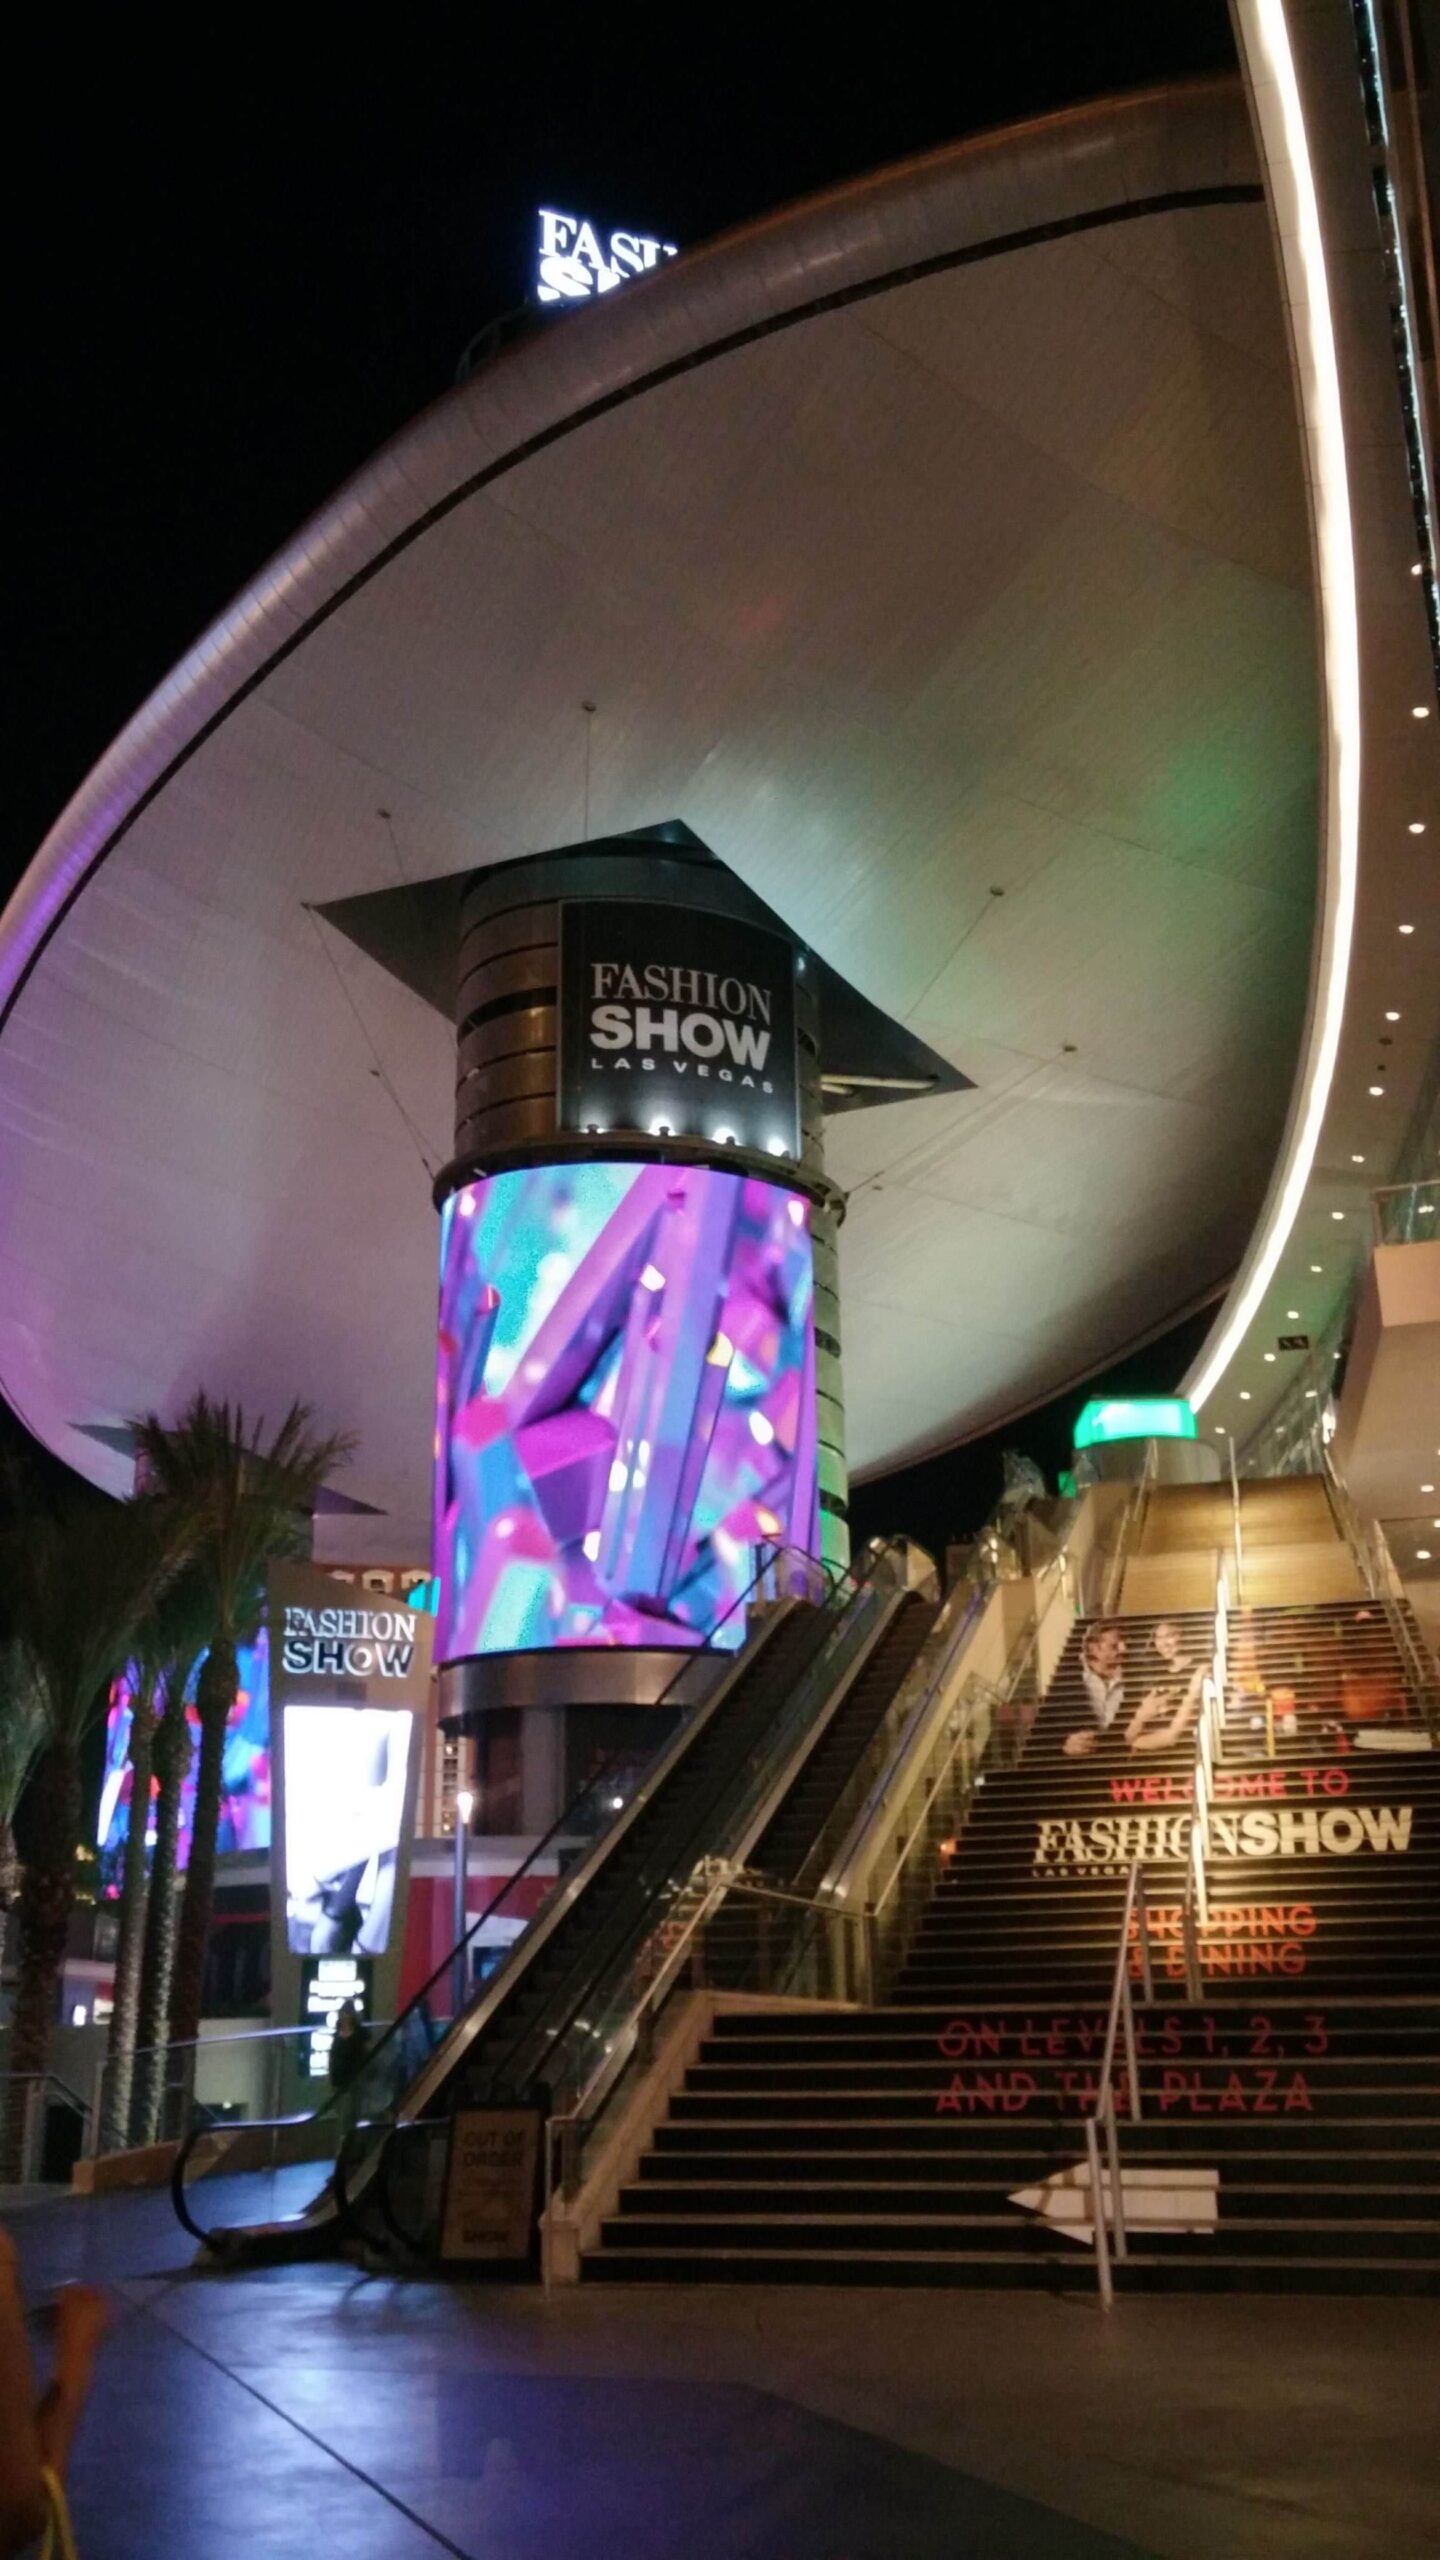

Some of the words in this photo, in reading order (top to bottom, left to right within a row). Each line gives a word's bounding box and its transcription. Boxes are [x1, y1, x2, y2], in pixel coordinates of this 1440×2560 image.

[590, 962, 772, 1026] FASHION
[589, 1004, 772, 1072] SHOW
[591, 1057, 657, 1071] LAS
[673, 1061, 774, 1095] VEGAS
[283, 1606, 418, 1642] FASHION
[282, 1639, 415, 1678] SHOW
[1300, 1766, 1350, 1798] TO
[1166, 1940, 1307, 1977] DINING
[937, 2018, 1006, 2056] ON
[1019, 2015, 1183, 2055] LEVELS
[1303, 2015, 1329, 2054] 3
[935, 2072, 1037, 2112] AND
[1054, 2070, 1132, 2112] THE
[1159, 2070, 1314, 2113] PLAZA
